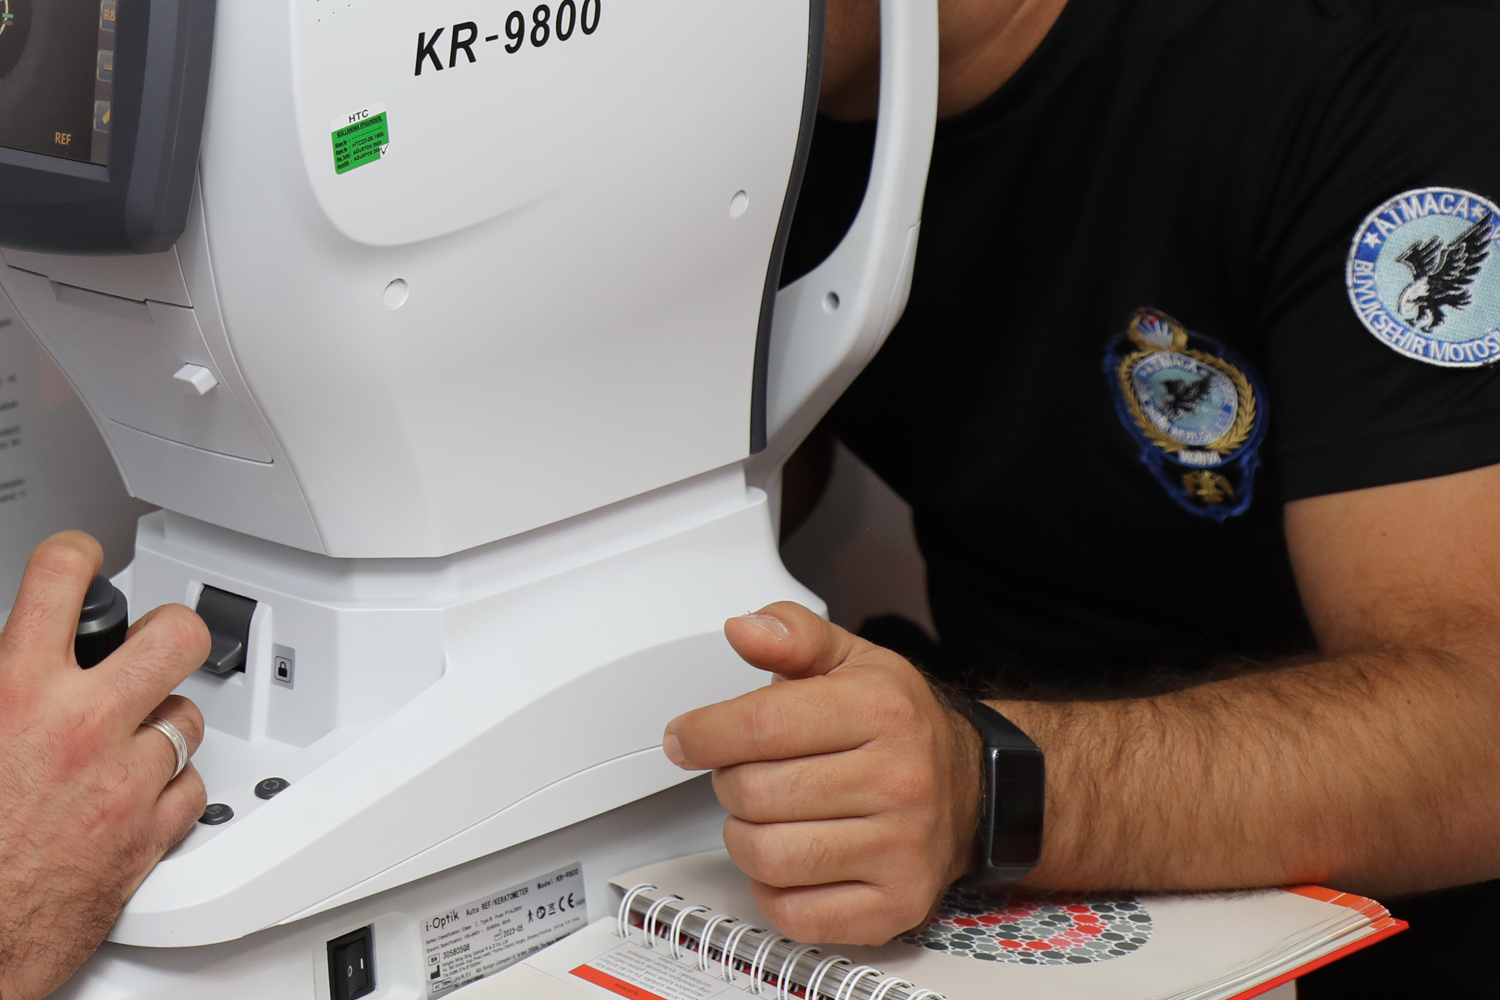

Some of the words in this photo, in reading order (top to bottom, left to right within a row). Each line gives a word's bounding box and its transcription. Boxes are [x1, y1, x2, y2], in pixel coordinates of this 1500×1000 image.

[348, 109, 369, 123] HTC
[54, 131, 72, 146] REF
[425, 911, 460, 932] i-Optik
